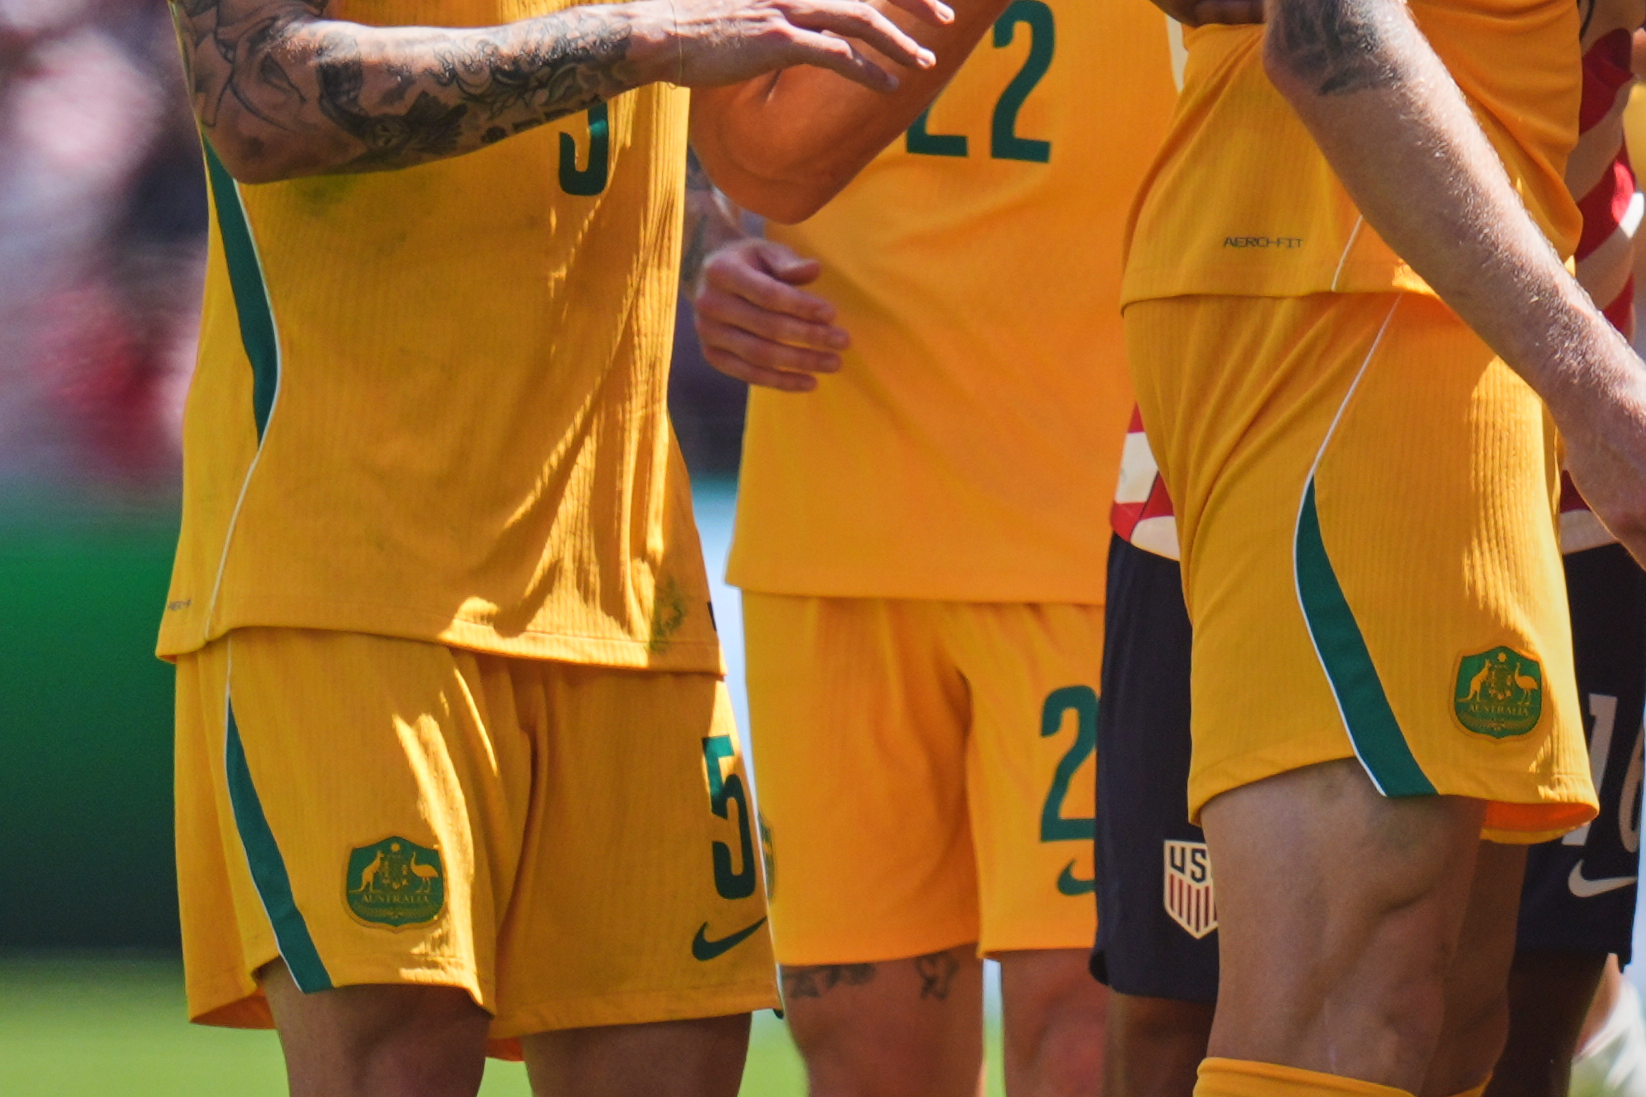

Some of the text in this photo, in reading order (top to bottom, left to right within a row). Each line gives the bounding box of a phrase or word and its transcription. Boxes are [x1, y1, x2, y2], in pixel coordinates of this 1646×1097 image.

[1470, 703, 1528, 716] AUSTRALIA
[702, 734, 756, 900] 5
[363, 894, 430, 904] AUSTRALIA
